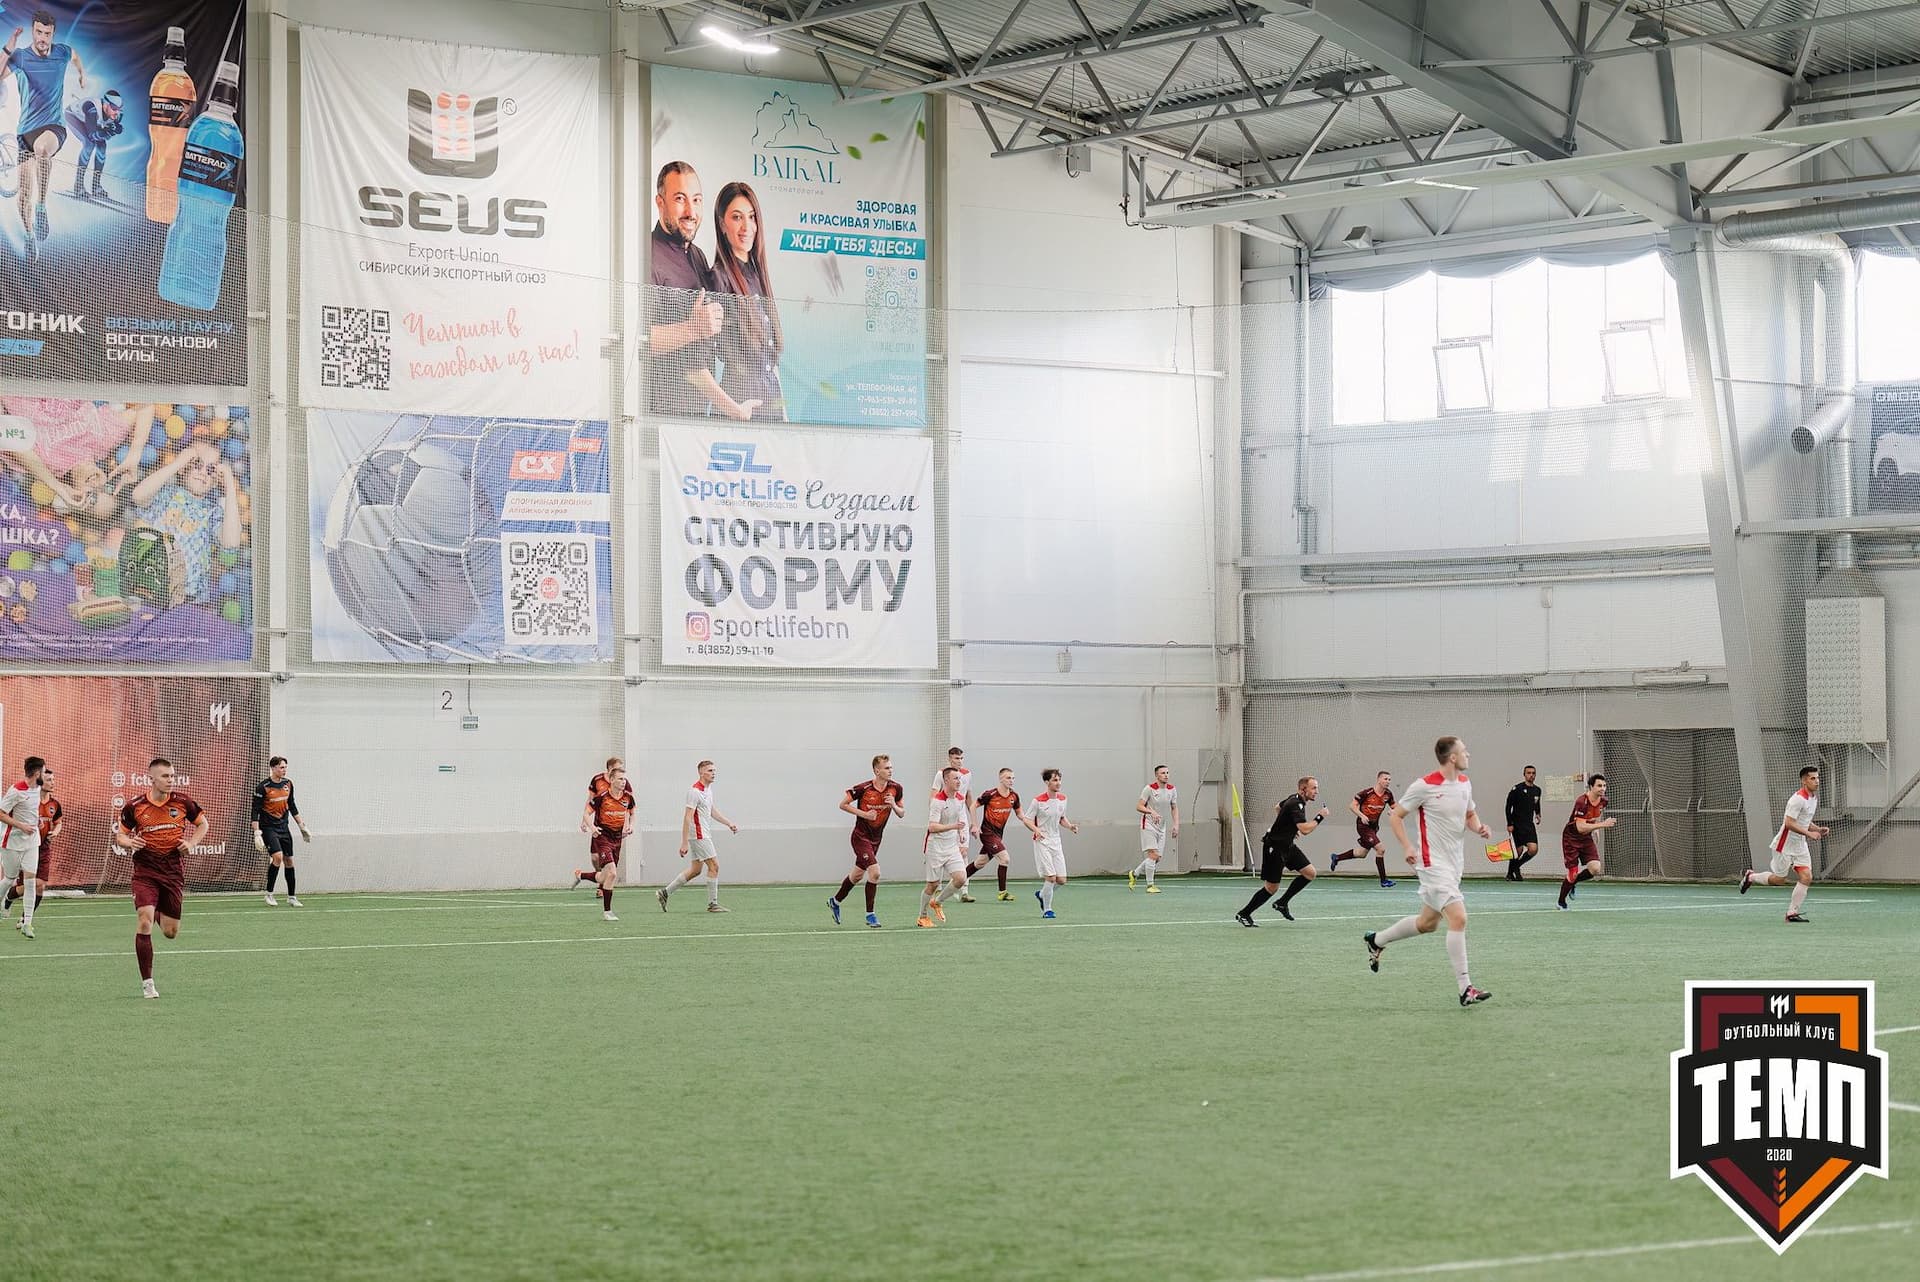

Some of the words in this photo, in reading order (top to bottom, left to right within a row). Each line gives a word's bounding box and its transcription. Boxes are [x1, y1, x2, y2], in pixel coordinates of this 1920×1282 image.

[754, 153, 841, 184] BAIKAL
[358, 185, 548, 239] SEUS
[856, 200, 917, 216] ЗДОРОВАЯ
[800, 213, 807, 224] И
[810, 213, 870, 229] КРАСИВАЯ
[873, 218, 917, 233] УЛЫБКА
[408, 242, 455, 261] Export
[459, 246, 500, 263] Union
[790, 233, 831, 251] ЖДЕТ
[833, 235, 866, 252] ТЕБЯ
[869, 239, 917, 256] ЗДЕСЬ!
[359, 260, 430, 277] СИБИРСКИЙ
[433, 266, 512, 283] ЭКСПОРТНЫЙ
[515, 272, 546, 284] СОЮЗ
[105, 316, 176, 331] ВОЗЬМИ
[403, 312, 504, 346] Чемпион
[506, 307, 522, 338] в
[105, 333, 218, 349] ВОССТАНОВИ
[106, 348, 158, 362] СИЛЫ.
[409, 345, 504, 380] каждом
[507, 350, 533, 375] из
[538, 329, 580, 364] нас!
[706, 442, 773, 473] SL
[682, 475, 798, 501] SportLife
[804, 479, 919, 520] Создаем
[684, 515, 913, 552] СПОРТИВНУЮ
[684, 553, 912, 612] ФОРМУ
[713, 614, 850, 643] sportlifebrn
[441, 690, 453, 710] 2
